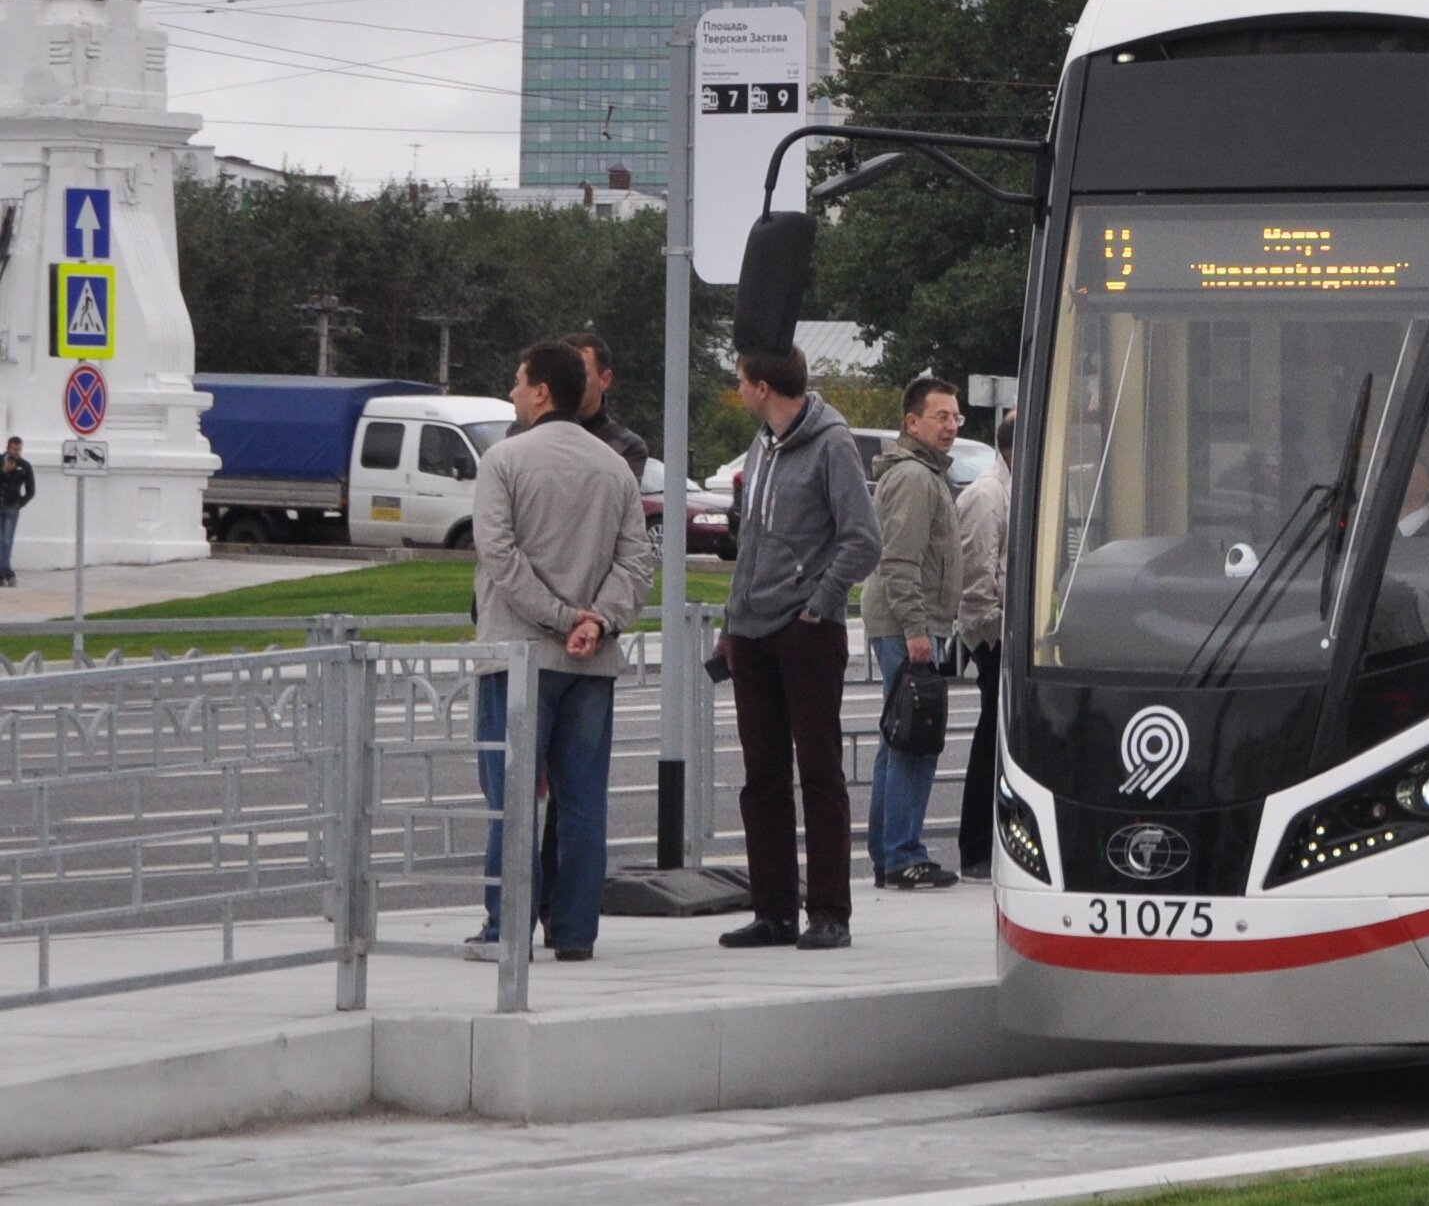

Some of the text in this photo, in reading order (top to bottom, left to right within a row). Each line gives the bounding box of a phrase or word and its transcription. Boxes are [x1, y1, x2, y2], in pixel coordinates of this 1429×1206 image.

[703, 21, 748, 31] Площадь
[703, 33, 788, 45] Тверская Застава
[728, 90, 739, 107] 7
[777, 89, 789, 107] 9
[1088, 898, 1214, 938] 31075
